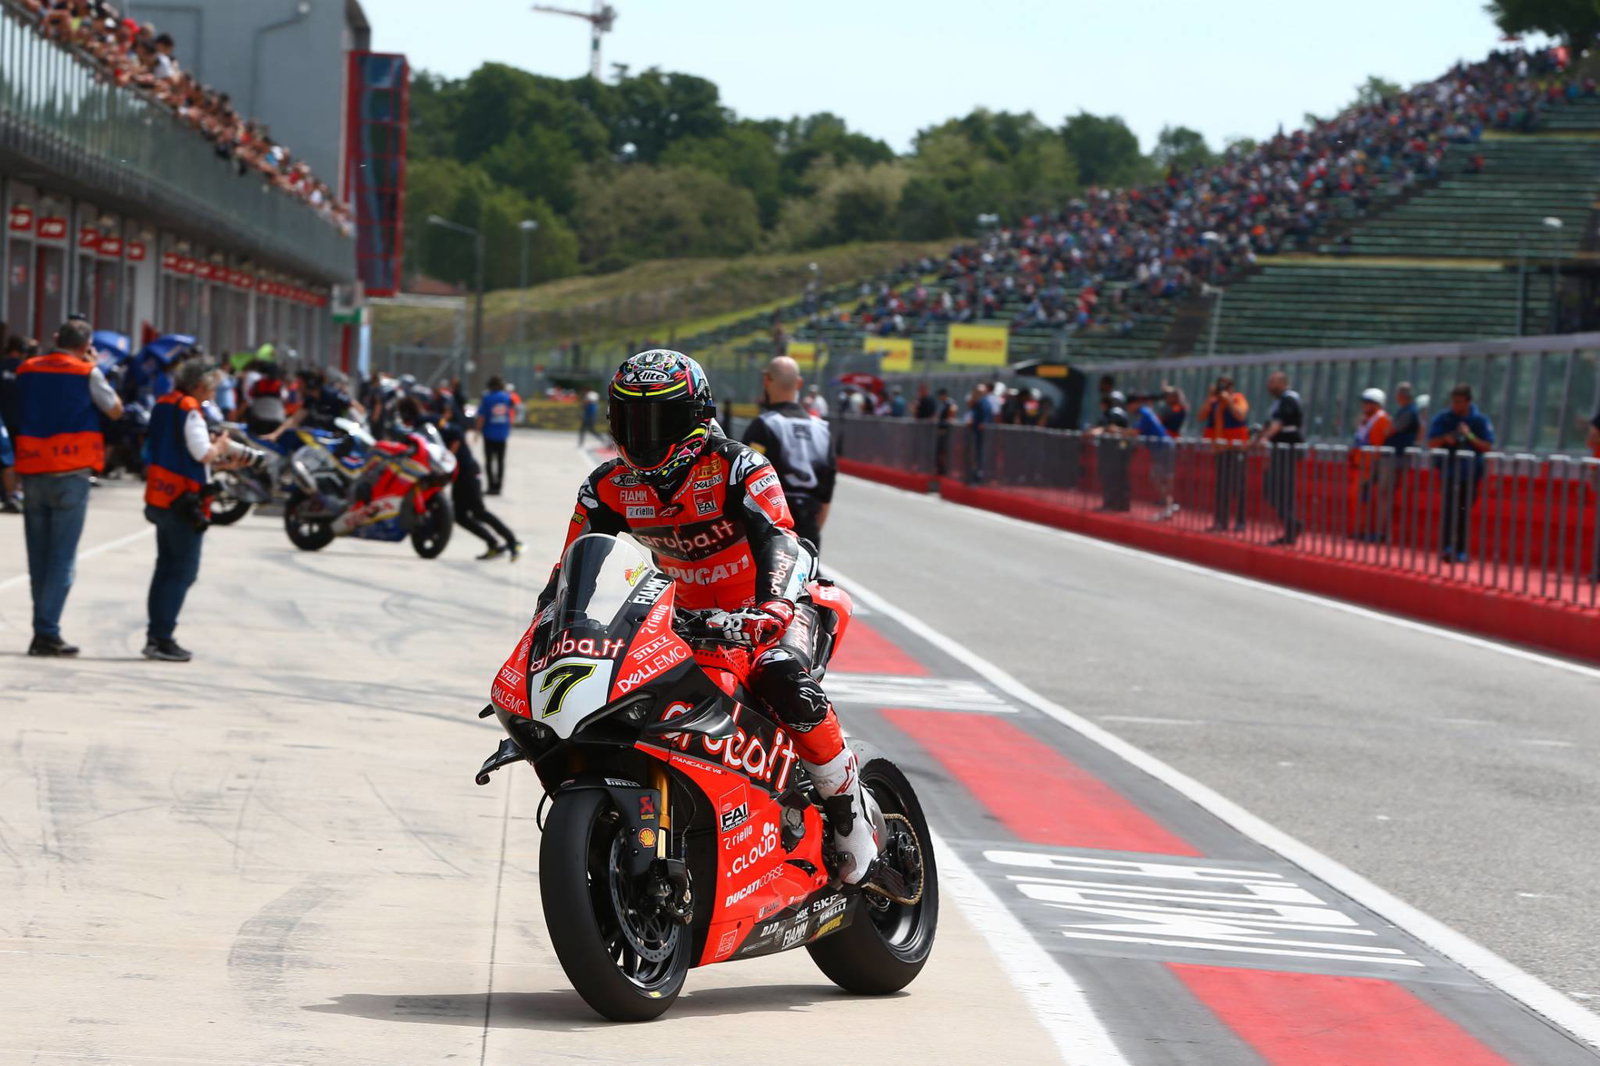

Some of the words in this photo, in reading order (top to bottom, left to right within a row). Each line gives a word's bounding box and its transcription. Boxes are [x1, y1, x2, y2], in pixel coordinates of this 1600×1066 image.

[627, 371, 665, 383] X-lite
[620, 490, 648, 502] FIAMM
[698, 502, 715, 512] FAI
[635, 507, 654, 515] riello
[666, 554, 750, 585] DUCATI
[632, 577, 670, 605] FIAMM
[530, 629, 626, 673] aruba.it
[633, 635, 670, 661] STULZ
[540, 663, 598, 719] 7
[722, 803, 747, 826] FAI
[732, 824, 753, 846] riello
[813, 894, 839, 912] SKF
